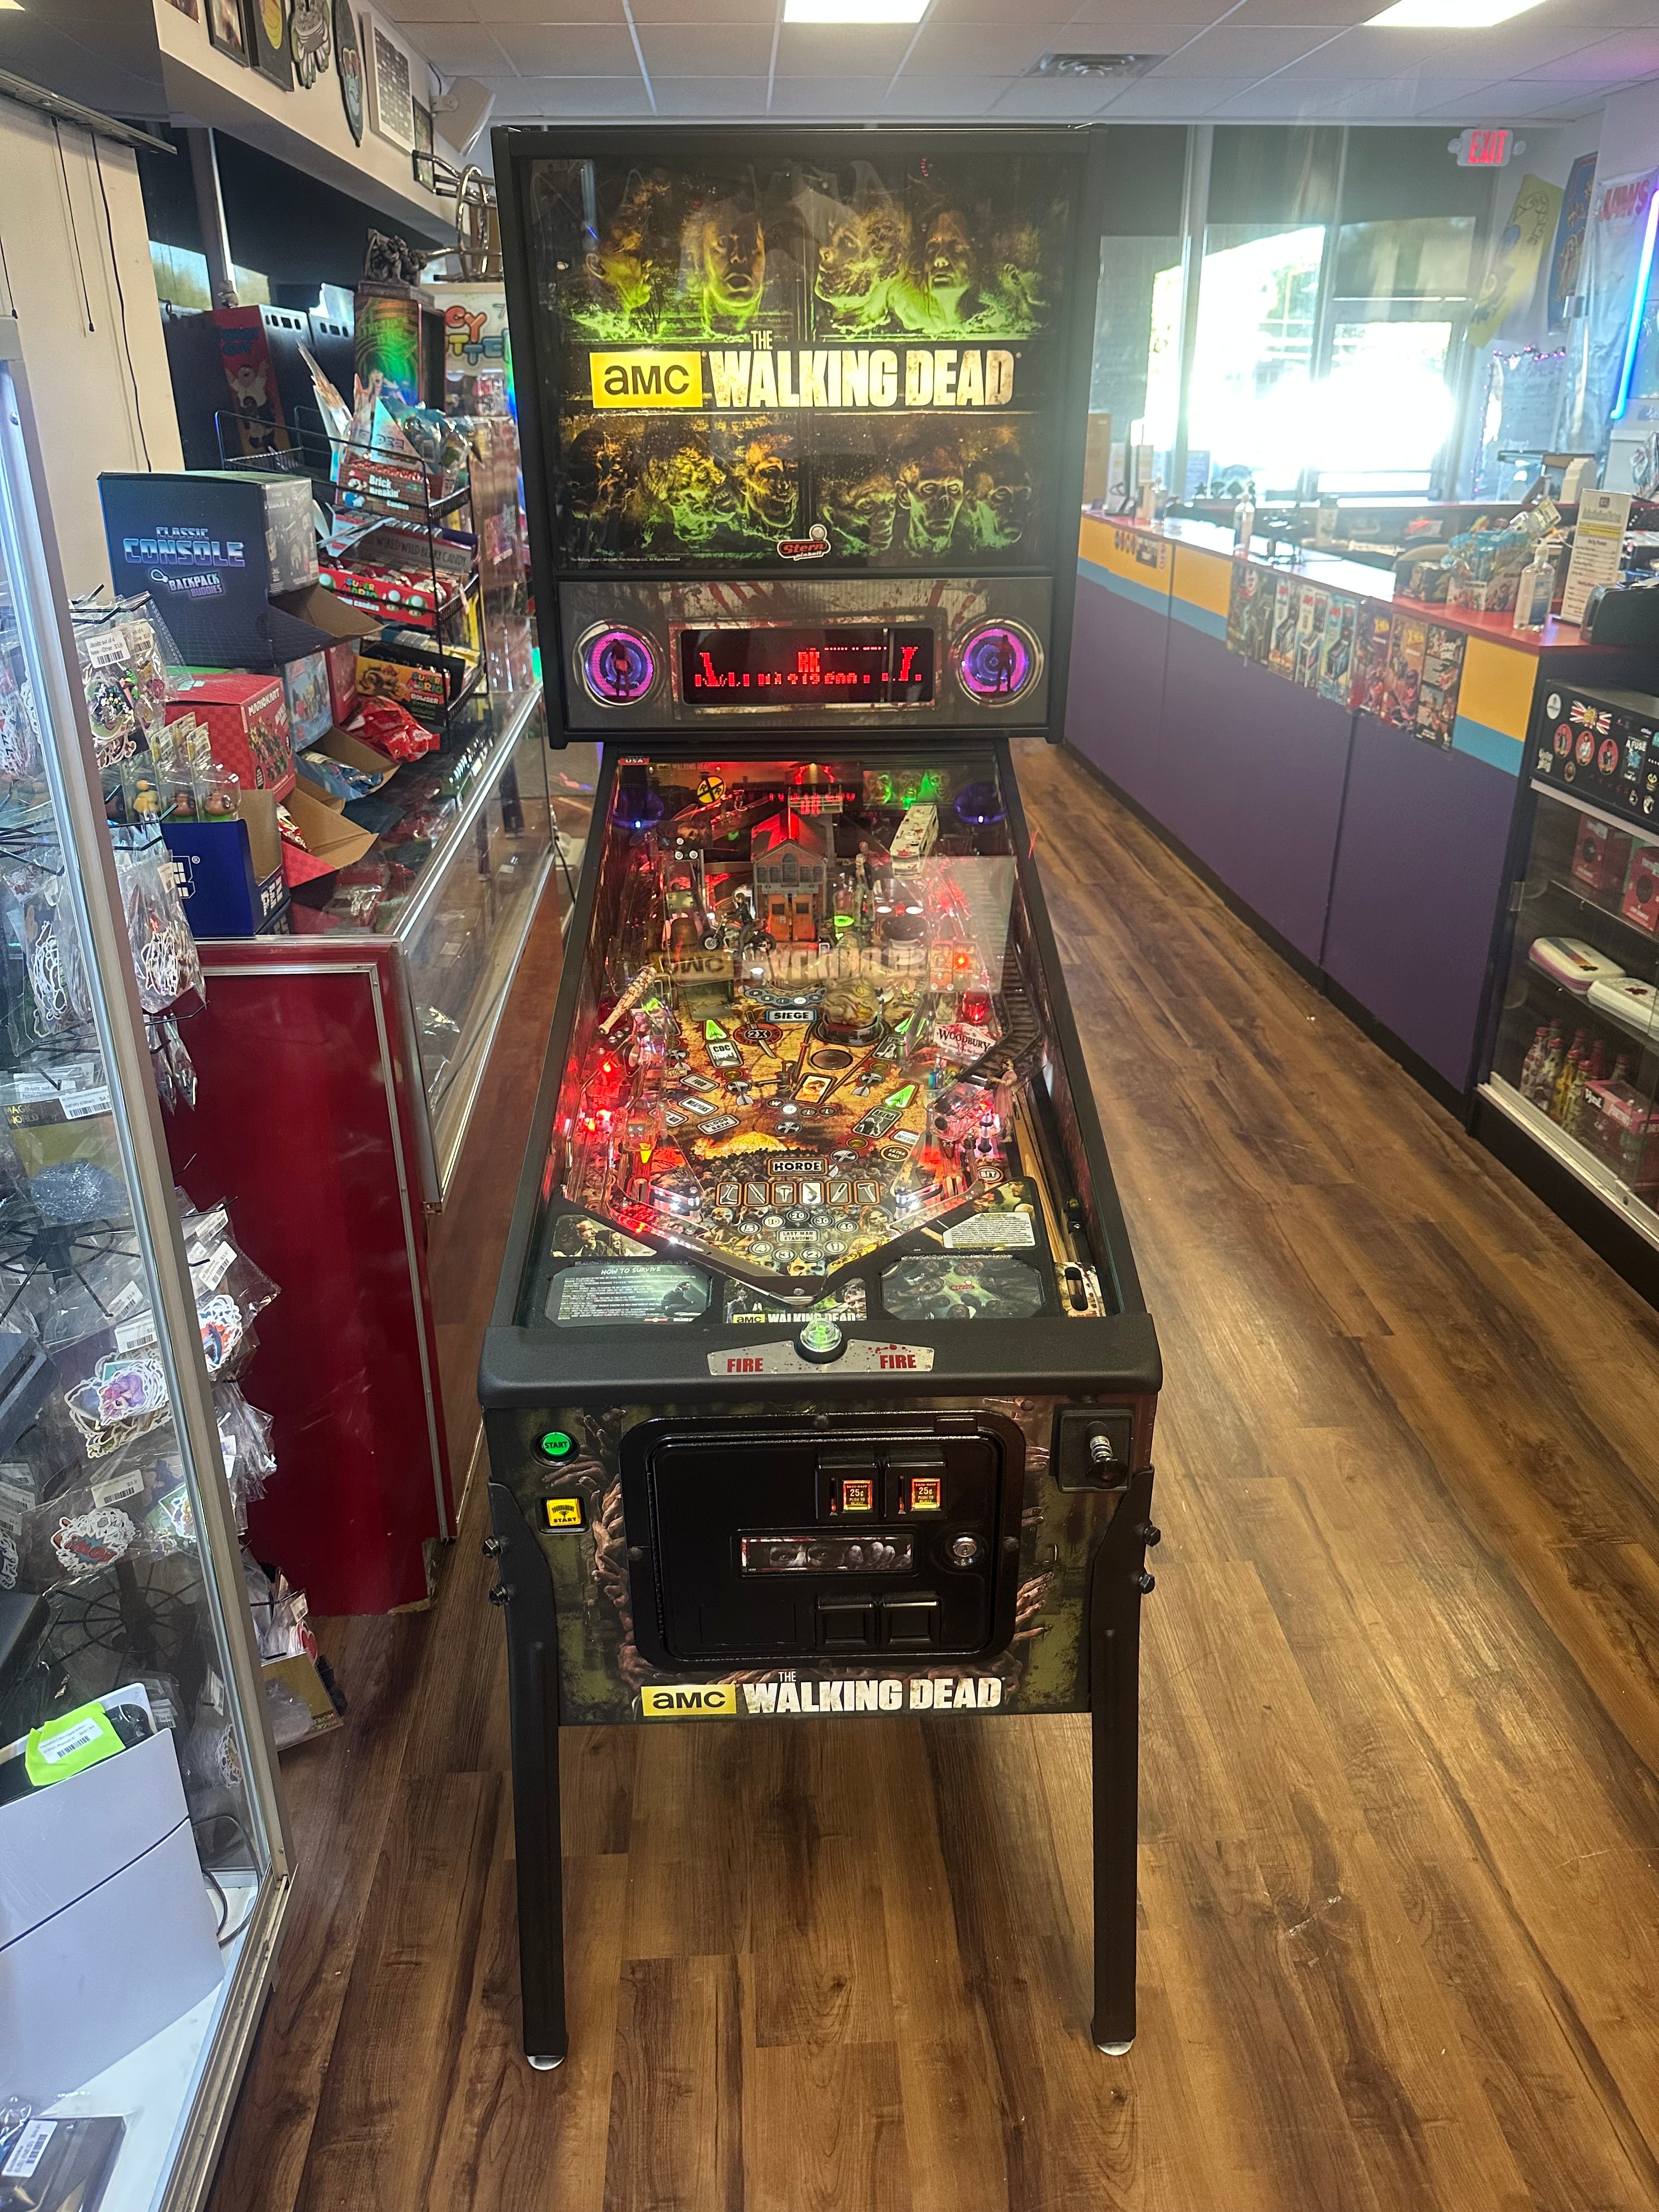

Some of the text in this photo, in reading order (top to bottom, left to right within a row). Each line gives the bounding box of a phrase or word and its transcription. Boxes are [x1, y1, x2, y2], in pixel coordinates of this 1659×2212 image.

[1468, 131, 1508, 163] EXIT
[751, 330, 773, 350] THE
[708, 351, 898, 408] WALKING
[905, 349, 1015, 407] DEAD
[369, 474, 392, 489] Brick
[156, 527, 210, 540] CLASSIC
[123, 538, 246, 567] CONSOLE
[783, 543, 824, 554] Stern
[442, 551, 466, 566] CANDY
[795, 551, 822, 559] pinball
[168, 573, 220, 592] BACKPACK
[346, 578, 376, 592] SUPER
[191, 584, 223, 597] BUDDIES
[341, 585, 379, 599] MARIO
[412, 672, 442, 685] SUPER
[405, 678, 444, 695] MARIO
[248, 688, 280, 716] MARIOKART
[411, 693, 439, 704] BOWSER
[1630, 740, 1646, 752] FUSE
[700, 784, 707, 792] R
[748, 1029, 768, 1039] 2X
[938, 1028, 991, 1052] WOODBURY
[691, 1078, 707, 1087] FOOD
[3, 1104, 34, 1115] MAGIC
[686, 1099, 710, 1113] WEAPONS
[7, 1113, 40, 1125] WORLD
[872, 1109, 895, 1120] ARENA
[705, 1117, 728, 1127] BLOOD
[712, 1121, 730, 1131] BATH
[888, 1148, 906, 1156] EXTRA
[773, 1161, 822, 1172] HORDE
[790, 1212, 805, 1220] 20
[744, 1224, 755, 1233] 5
[754, 1244, 766, 1253] 4
[831, 1243, 839, 1251] 1
[778, 1250, 791, 1259] 3
[806, 1250, 819, 1259] 2
[727, 1354, 917, 1373] FIRE FIRE
[544, 1441, 568, 1449] START
[850, 1488, 864, 1497] 25¢
[918, 1487, 933, 1496] 25¢
[551, 1504, 575, 1514] TOURNAMENT
[778, 1671, 797, 1683] THE
[742, 1679, 903, 1714] WALKING
[909, 1677, 1002, 1709] DEAD
